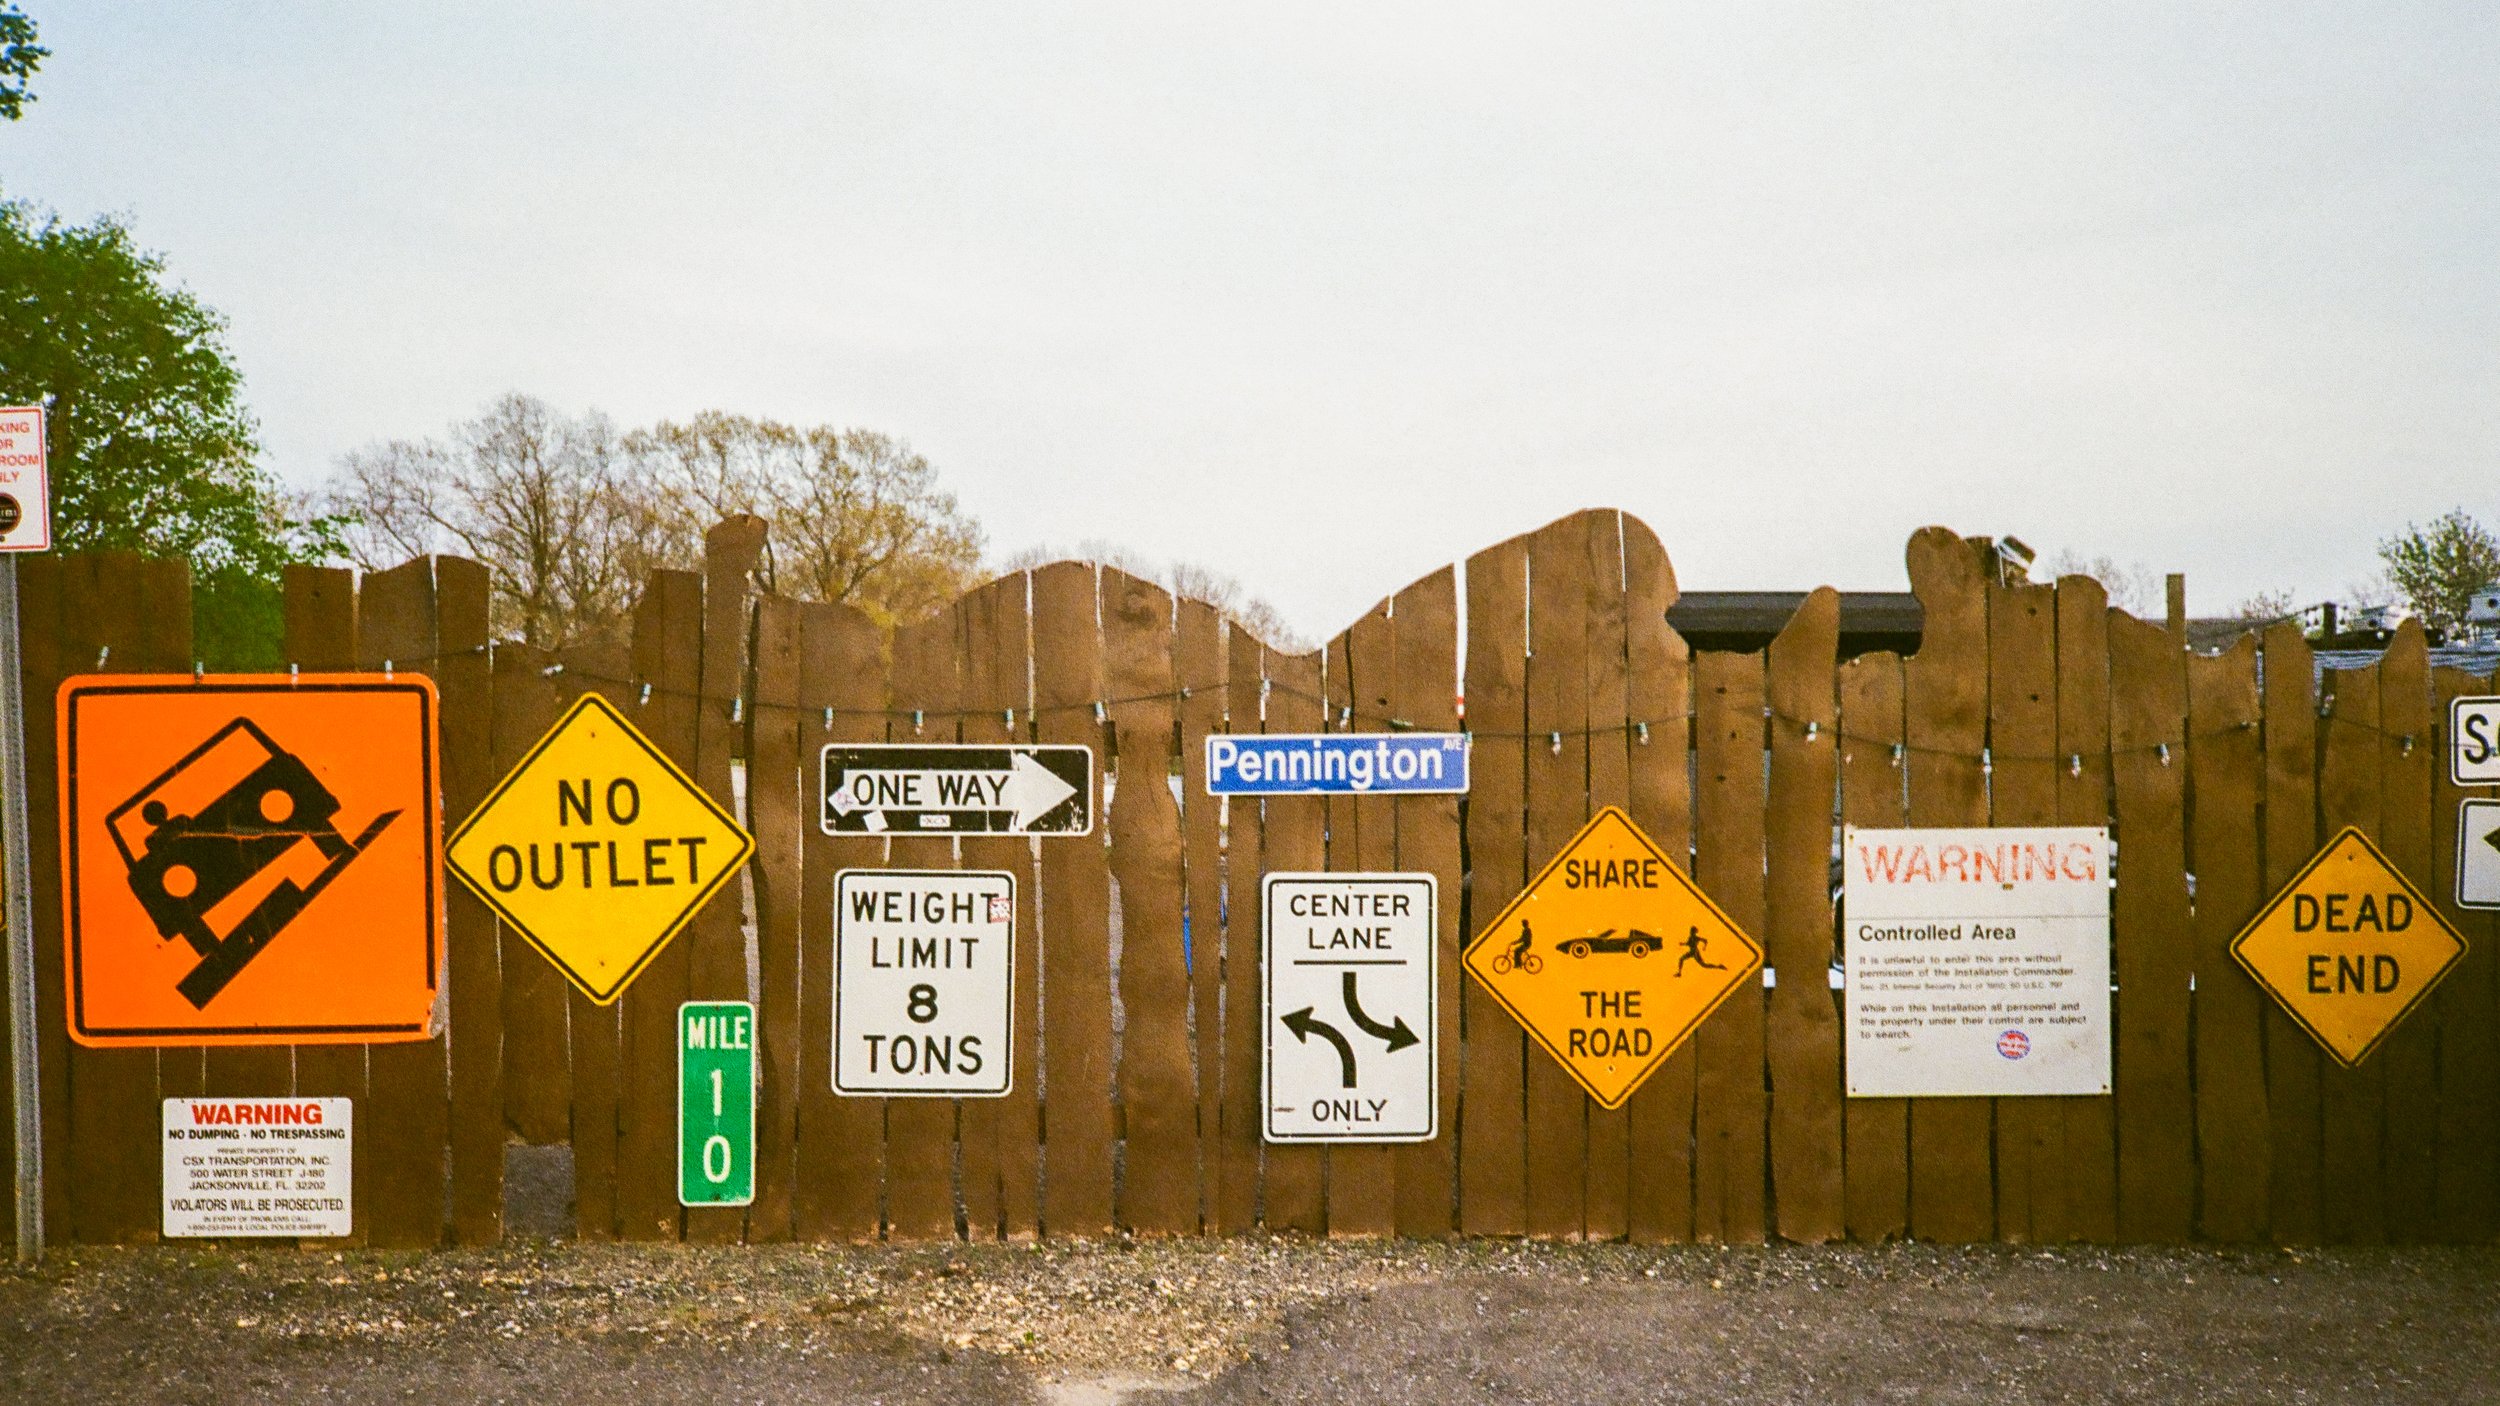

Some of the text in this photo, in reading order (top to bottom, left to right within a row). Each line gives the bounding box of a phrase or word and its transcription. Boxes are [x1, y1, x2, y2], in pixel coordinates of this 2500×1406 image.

[2464, 713, 2500, 765] S
[1211, 738, 1463, 791] Pennington AVE
[558, 778, 640, 826] NO
[853, 774, 1009, 806] ONE WAY
[488, 837, 708, 893] OUTLET
[1565, 859, 1658, 889] SHARE
[1858, 842, 2096, 883] WARNING
[851, 892, 999, 924] WEIGHT
[1290, 894, 1411, 917] CENTER
[2293, 893, 2414, 933] DEAD
[1308, 927, 1392, 949] LANE
[1859, 925, 2016, 941] Controlled Area
[871, 937, 979, 969] LIMIT
[1860, 956, 1866, 964] It
[1884, 955, 1925, 964] unlawful
[1930, 955, 1940, 963] to
[1976, 955, 1993, 963] this
[1860, 970, 1913, 978] permission
[1919, 968, 1929, 977] of
[1955, 968, 2008, 976] Installation
[2307, 954, 2400, 994] END
[907, 983, 939, 1023] 8
[1580, 991, 1642, 1018] THE
[1861, 1004, 1886, 1012] While
[1908, 1004, 1926, 1012] this
[1932, 1003, 1986, 1012] Installation
[1991, 1003, 2002, 1011] all
[2006, 1003, 2056, 1012] personnel
[2061, 1003, 2080, 1011] and
[688, 1015, 749, 1051] MILE
[1860, 1030, 1871, 1038] to
[1880, 1018, 1922, 1027] property
[1928, 1017, 1956, 1025] under
[1989, 1016, 2024, 1024] control
[2049, 1015, 2086, 1024] subject
[862, 1035, 983, 1076] TONS
[1569, 1028, 1653, 1057] ROAD
[191, 1104, 323, 1125] WARNING
[1312, 1099, 1387, 1122] ONLY
[168, 1129, 345, 1140] NO DUMPING NO TRESPASSING
[182, 1156, 205, 1166] CSX
[190, 1168, 209, 1179] 500
[212, 1168, 248, 1178] WATER
[251, 1168, 293, 1178] STREET
[295, 1180, 326, 1190] 32202
[170, 1198, 227, 1211] VIOLATORS
[231, 1198, 254, 1211] WILL
[258, 1198, 271, 1211] BE
